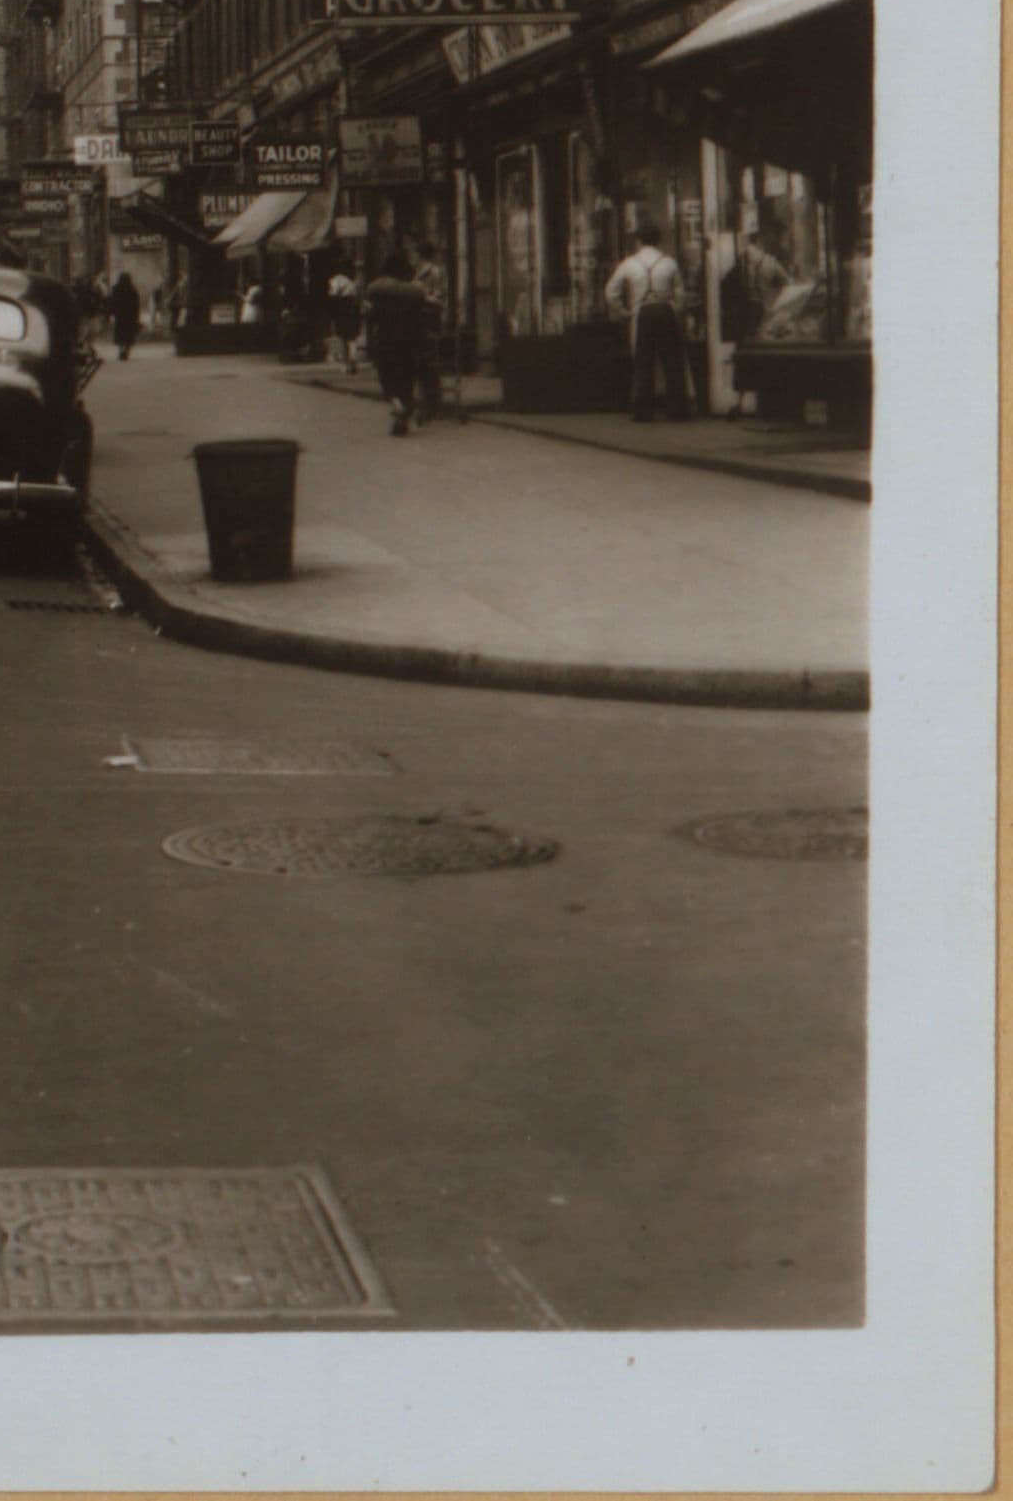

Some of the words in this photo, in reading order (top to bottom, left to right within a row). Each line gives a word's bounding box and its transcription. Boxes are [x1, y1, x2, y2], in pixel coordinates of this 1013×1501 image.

[194, 128, 238, 142] BEAUTY
[201, 143, 234, 158] SHOP
[256, 145, 323, 162] TAILOR
[257, 172, 321, 186] PRESSING
